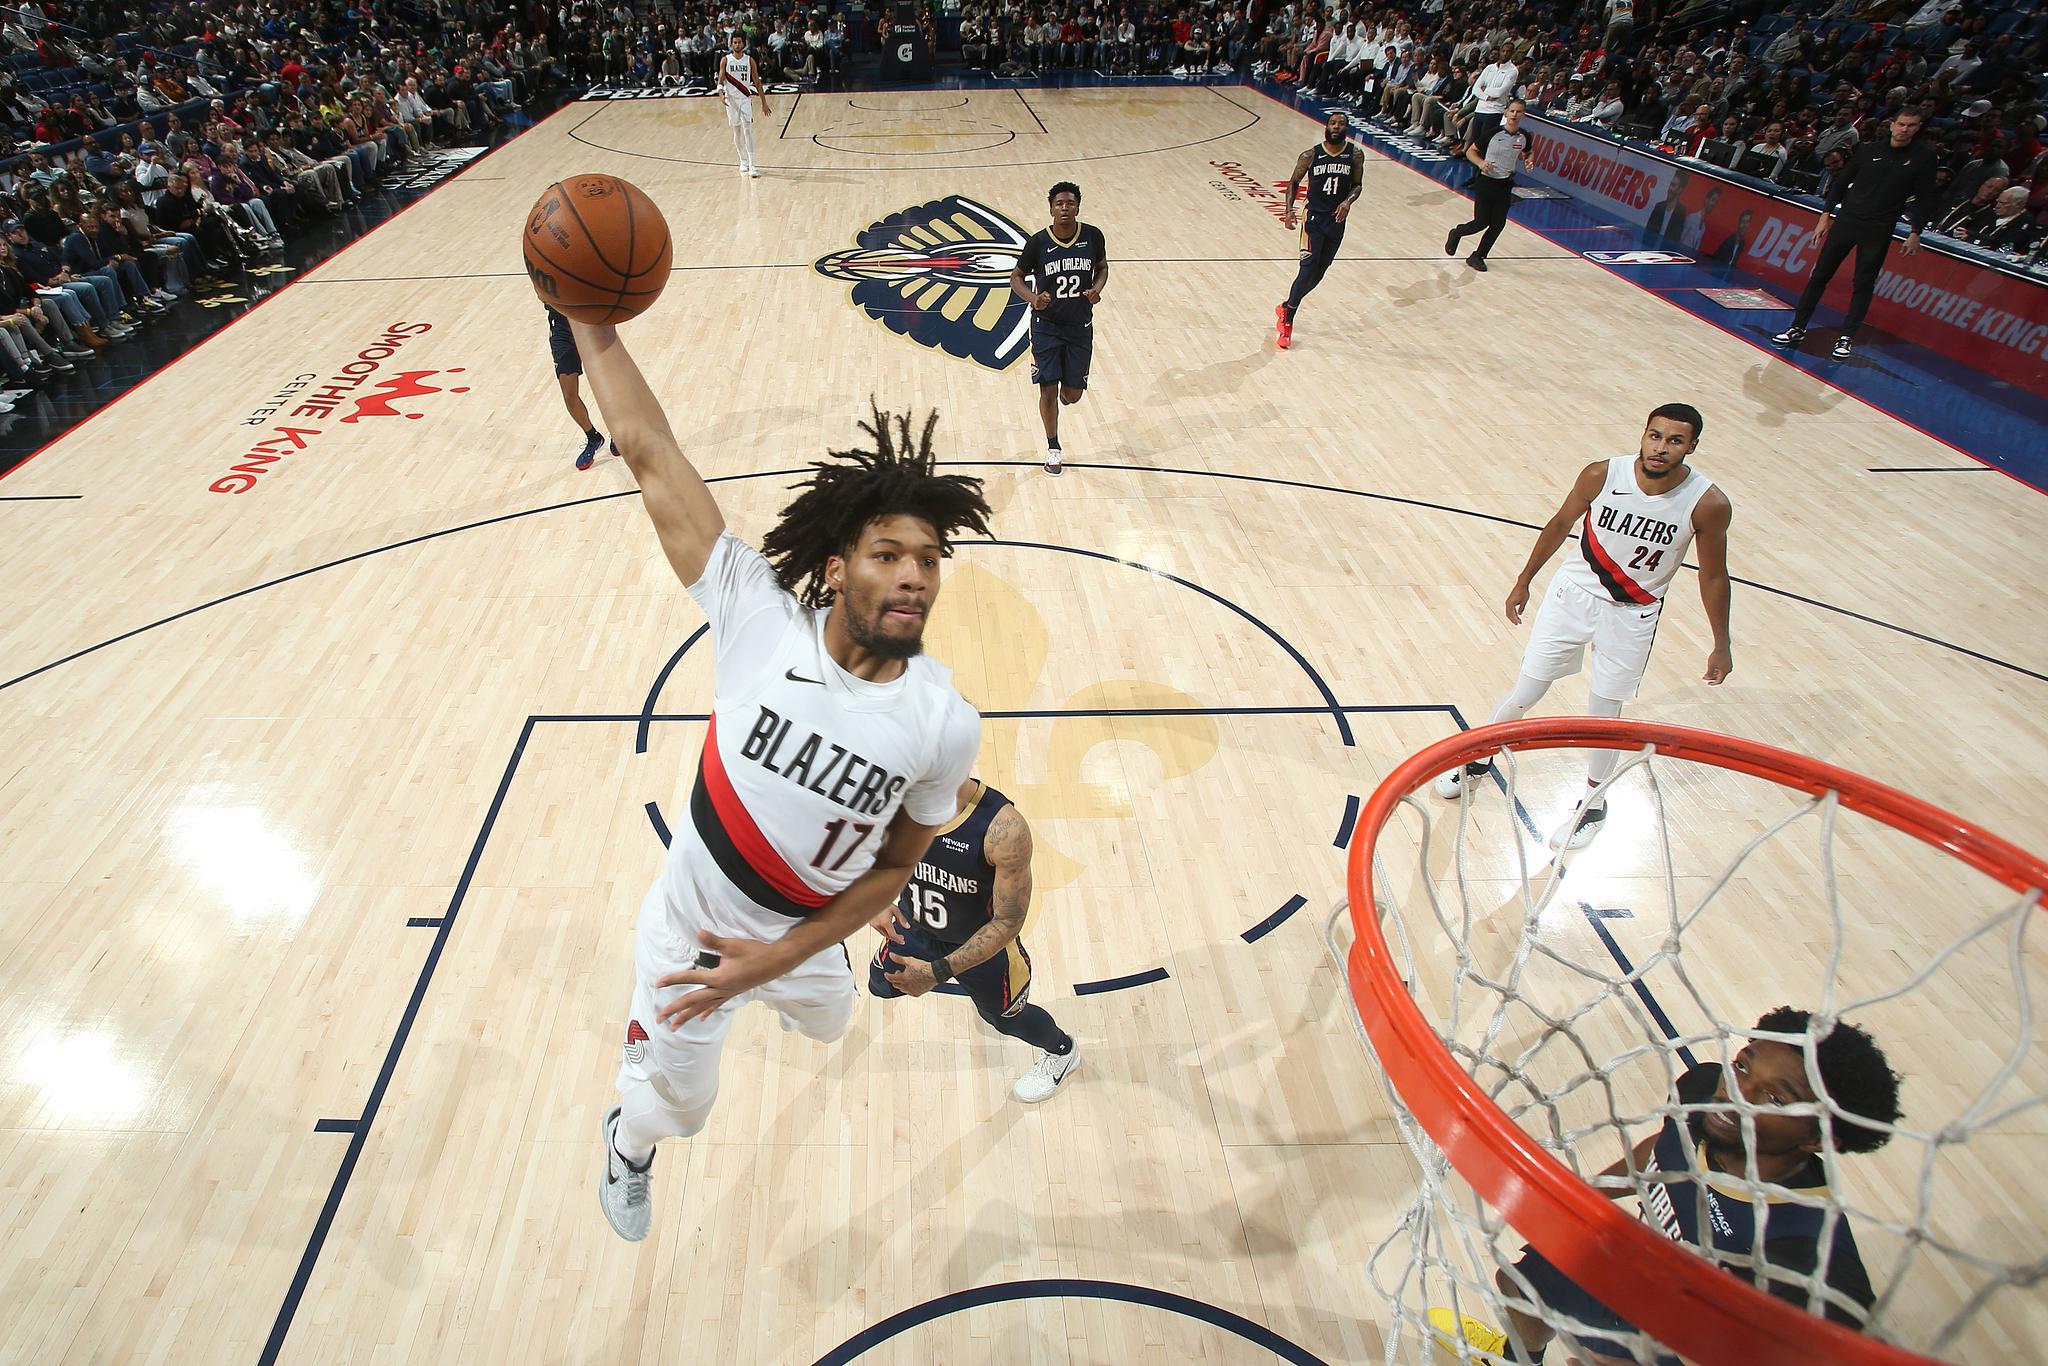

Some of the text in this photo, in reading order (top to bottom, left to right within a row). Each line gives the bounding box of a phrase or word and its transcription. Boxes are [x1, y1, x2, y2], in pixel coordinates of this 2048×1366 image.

[580, 83, 800, 100] PELICS
[1209, 160, 1278, 199] SMOOTHIE
[1313, 163, 1351, 176] NEW ORLEANS
[1322, 176, 1339, 196] 41
[1518, 131, 1658, 210] NAS BROTHERS
[1748, 215, 1817, 274] DEC
[1044, 257, 1092, 277] NEW ORLEANS
[1056, 275, 1081, 299] 22
[1873, 267, 2048, 355] MOOTHIE KING
[289, 321, 432, 419] SMOOTHIE
[240, 373, 317, 426] CENTER
[1597, 505, 1679, 546] BLAZERS
[1628, 545, 1665, 572] 24
[740, 704, 907, 816] BLAZERS
[809, 817, 875, 872] 17
[942, 836, 970, 851] NEWAGE
[914, 861, 978, 894] ORLEANS
[908, 882, 948, 930] 15
[1706, 1192, 1734, 1238] NEWAGE
